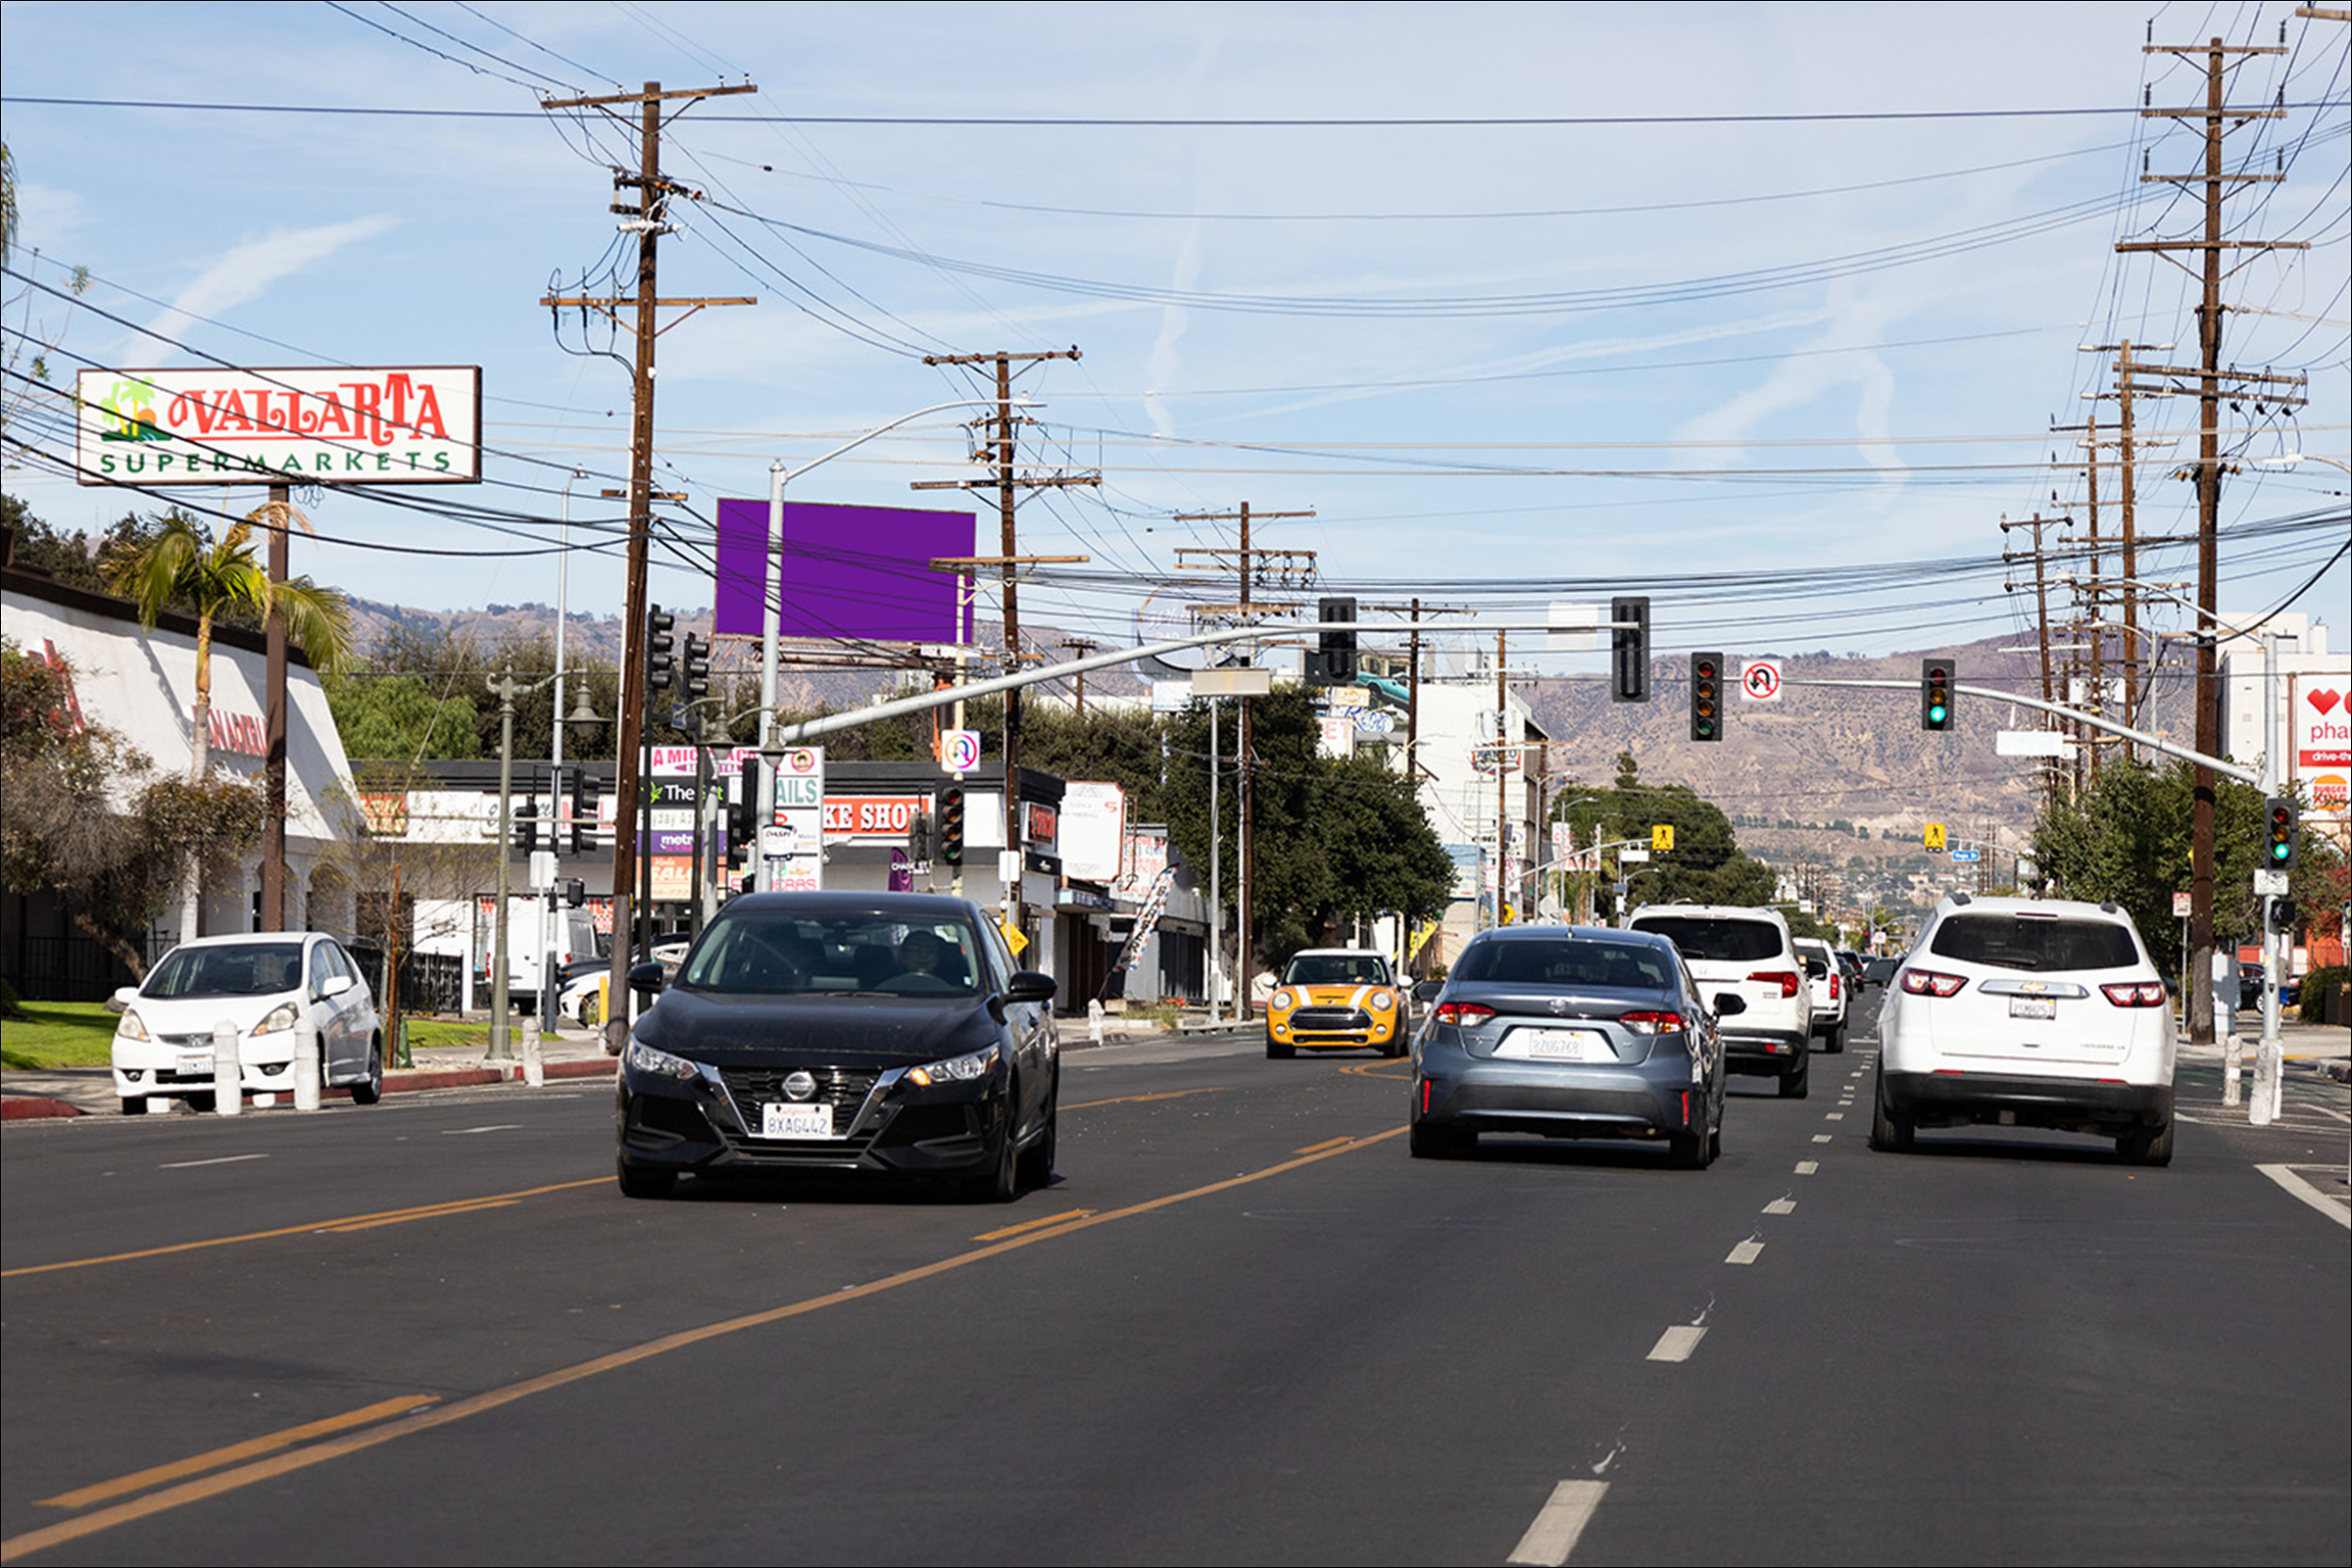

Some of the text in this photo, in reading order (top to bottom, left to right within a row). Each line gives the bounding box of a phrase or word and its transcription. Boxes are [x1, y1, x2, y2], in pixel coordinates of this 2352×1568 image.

[168, 373, 450, 447] VALLARTA
[100, 451, 450, 473] SUPERMARKETS
[664, 785, 696, 801] The
[776, 779, 817, 804] AILS
[823, 804, 853, 829] KE
[767, 1118, 827, 1134] 8XAG442
